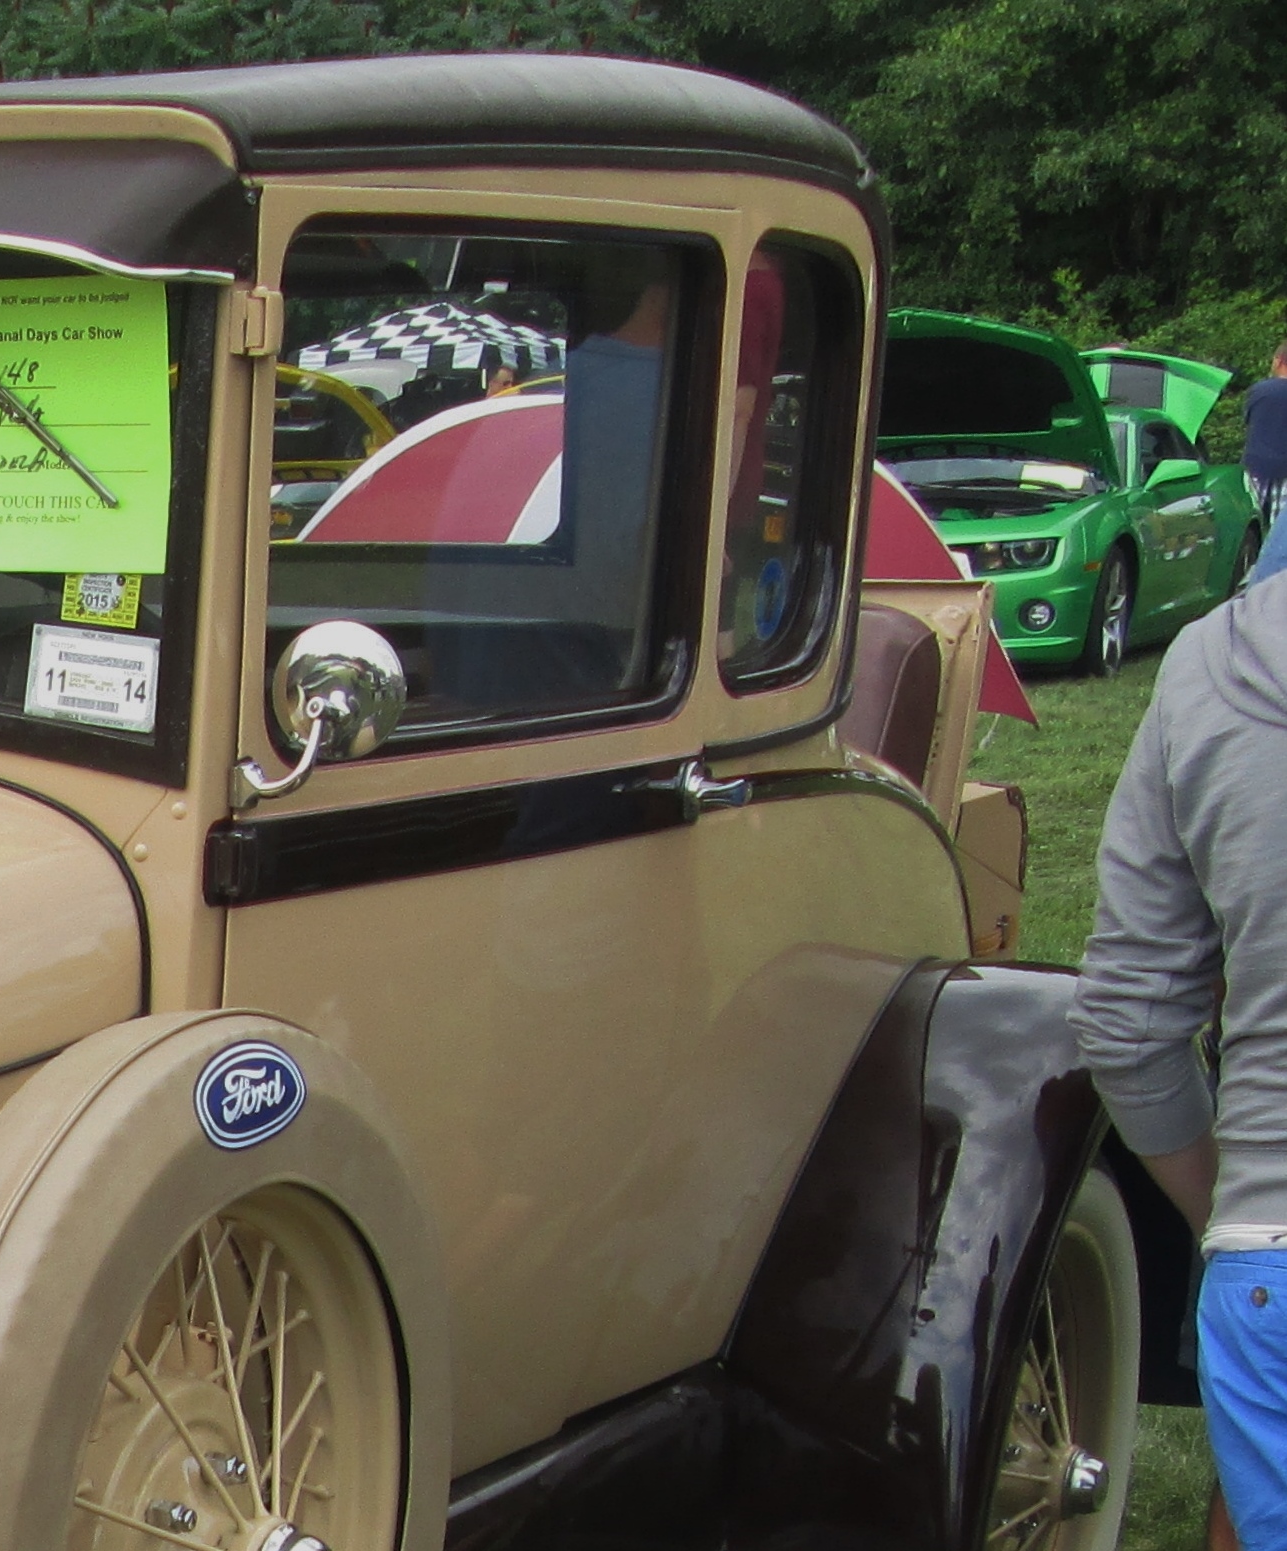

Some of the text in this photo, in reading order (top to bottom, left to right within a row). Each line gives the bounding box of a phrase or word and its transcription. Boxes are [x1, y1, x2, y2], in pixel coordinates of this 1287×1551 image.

[26, 327, 58, 345] Days
[62, 326, 84, 341] Car
[88, 325, 123, 340] Show
[49, 495, 82, 509] THIS
[86, 495, 121, 509] CA
[77, 592, 109, 609] 2015
[45, 668, 67, 693] 11
[124, 678, 147, 704] 14
[221, 1065, 286, 1124] Ford
